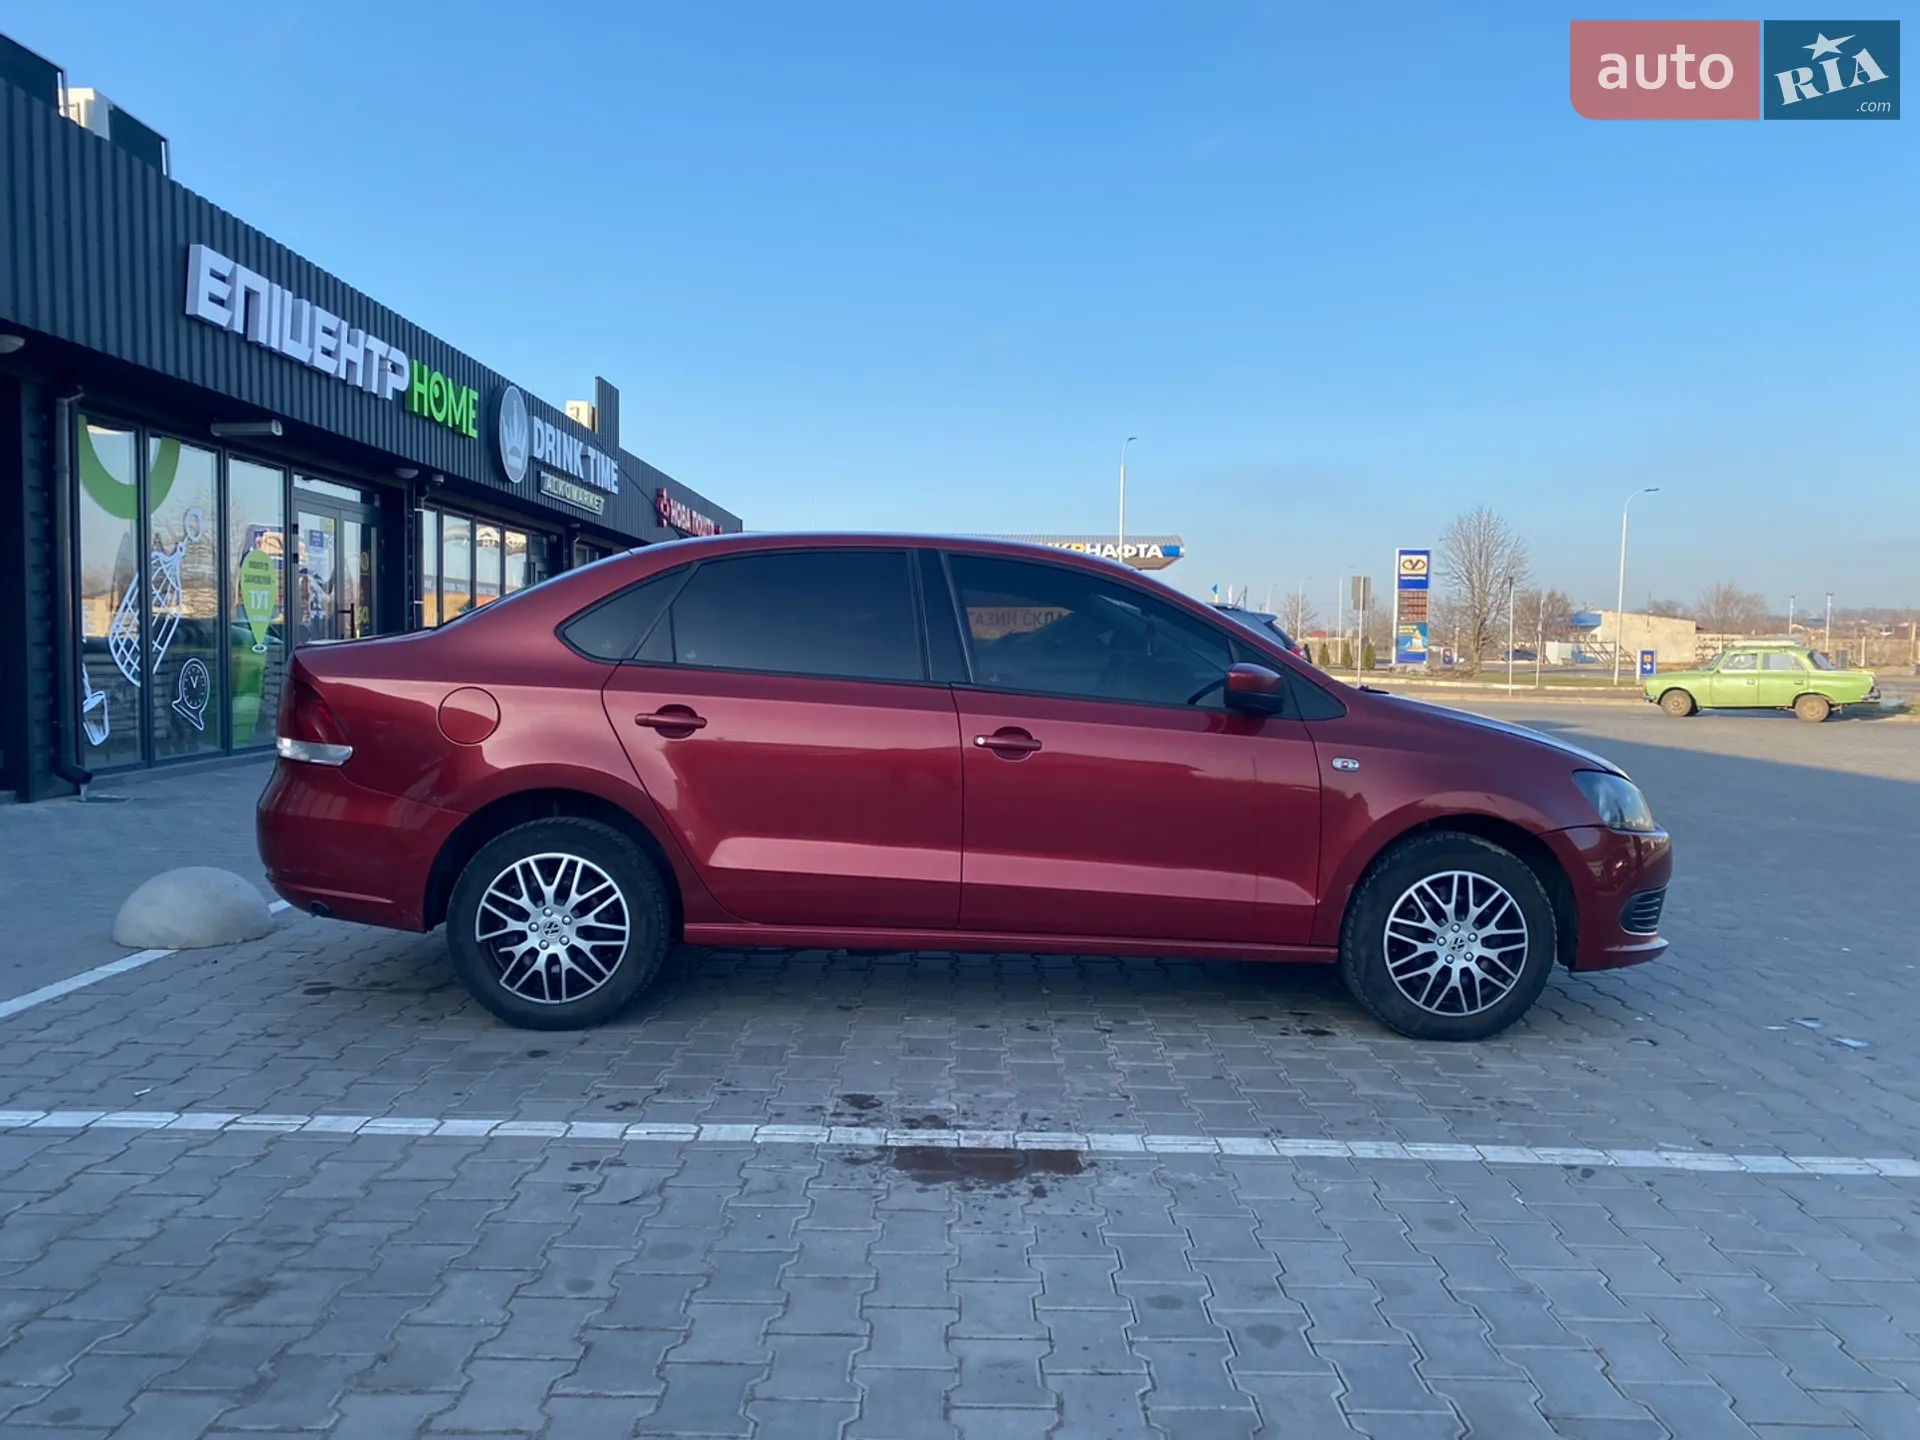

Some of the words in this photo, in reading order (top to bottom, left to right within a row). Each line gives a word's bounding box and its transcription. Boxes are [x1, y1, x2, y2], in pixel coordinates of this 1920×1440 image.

[185, 243, 411, 400] ЕПІЦЕНТР
[410, 358, 479, 439] HOME
[533, 415, 584, 480] DRINK
[587, 445, 619, 495] TIME
[248, 590, 270, 610] ТУТ
